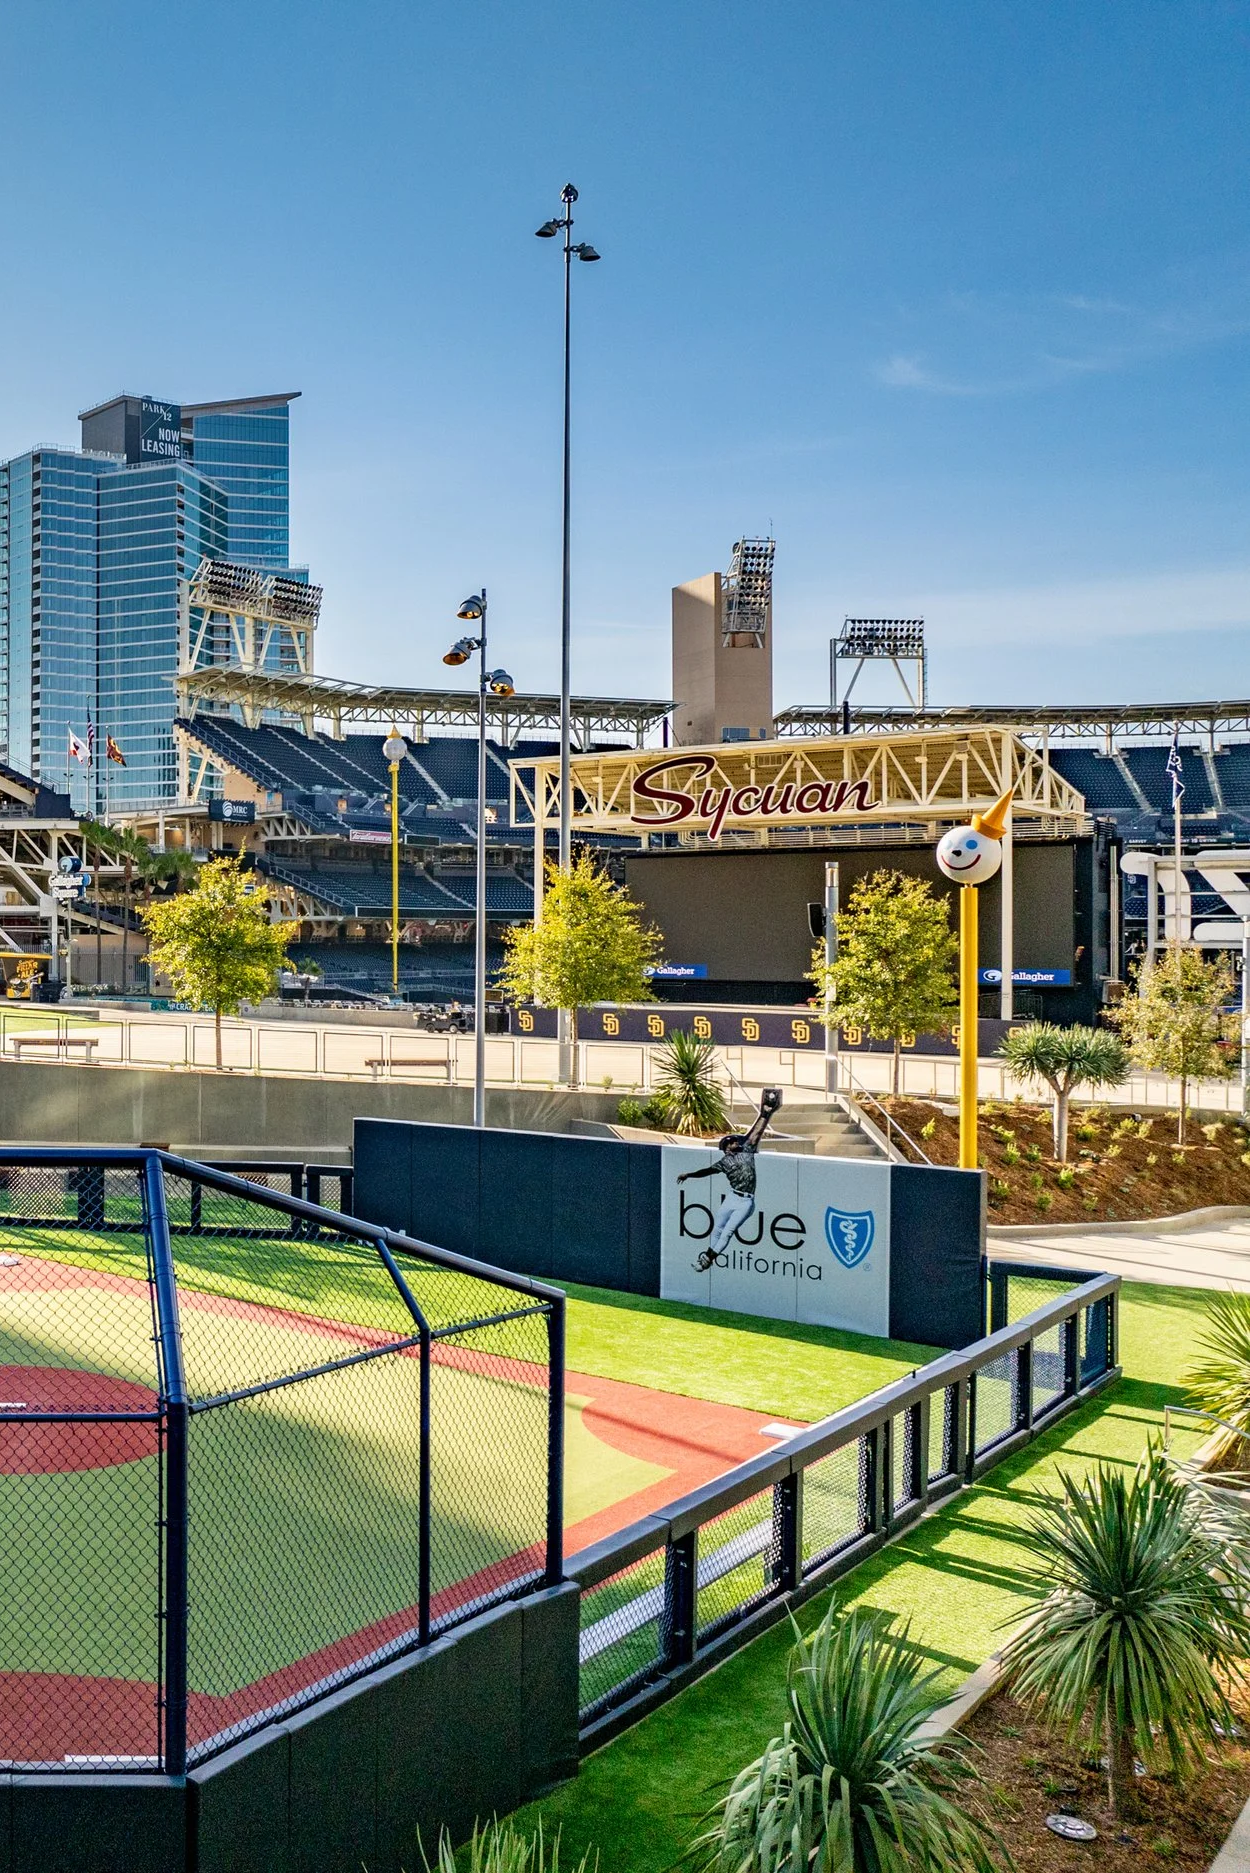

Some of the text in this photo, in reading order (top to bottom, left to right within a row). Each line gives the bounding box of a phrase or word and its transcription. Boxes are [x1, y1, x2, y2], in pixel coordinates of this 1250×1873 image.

[142, 402, 165, 414] PARK
[163, 411, 172, 421] 12
[158, 427, 180, 443] NOW
[141, 438, 180, 457] LEASING
[630, 754, 882, 842] Sycuan
[232, 805, 248, 814] MRC
[657, 966, 695, 976] Gallagher
[518, 1010, 534, 1032] SD
[602, 1012, 620, 1036] SD
[647, 1014, 665, 1037] SD
[741, 1017, 760, 1042] SD
[791, 1019, 811, 1044] SD
[679, 1190, 807, 1250] bue
